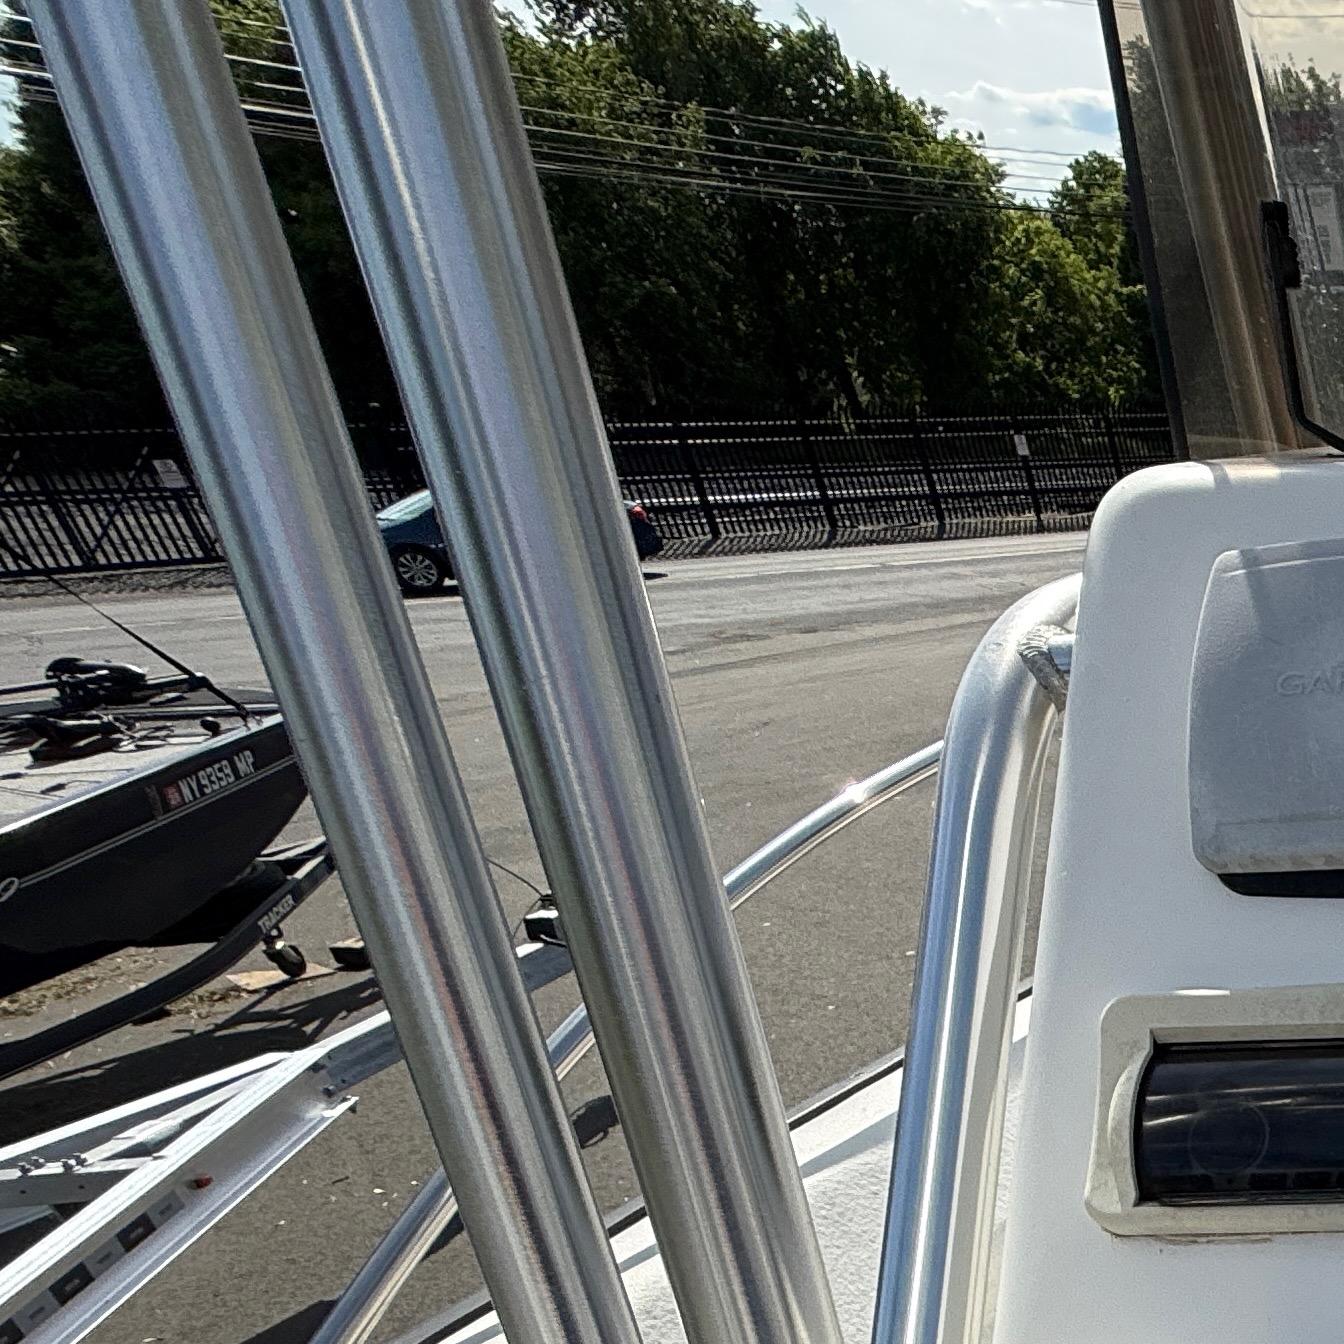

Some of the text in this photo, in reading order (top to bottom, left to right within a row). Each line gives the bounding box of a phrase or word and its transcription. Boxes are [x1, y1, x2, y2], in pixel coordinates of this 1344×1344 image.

[178, 775, 201, 803] NY
[198, 759, 236, 795] 9359
[233, 750, 255, 776] MP
[257, 894, 297, 934] TRACKER
